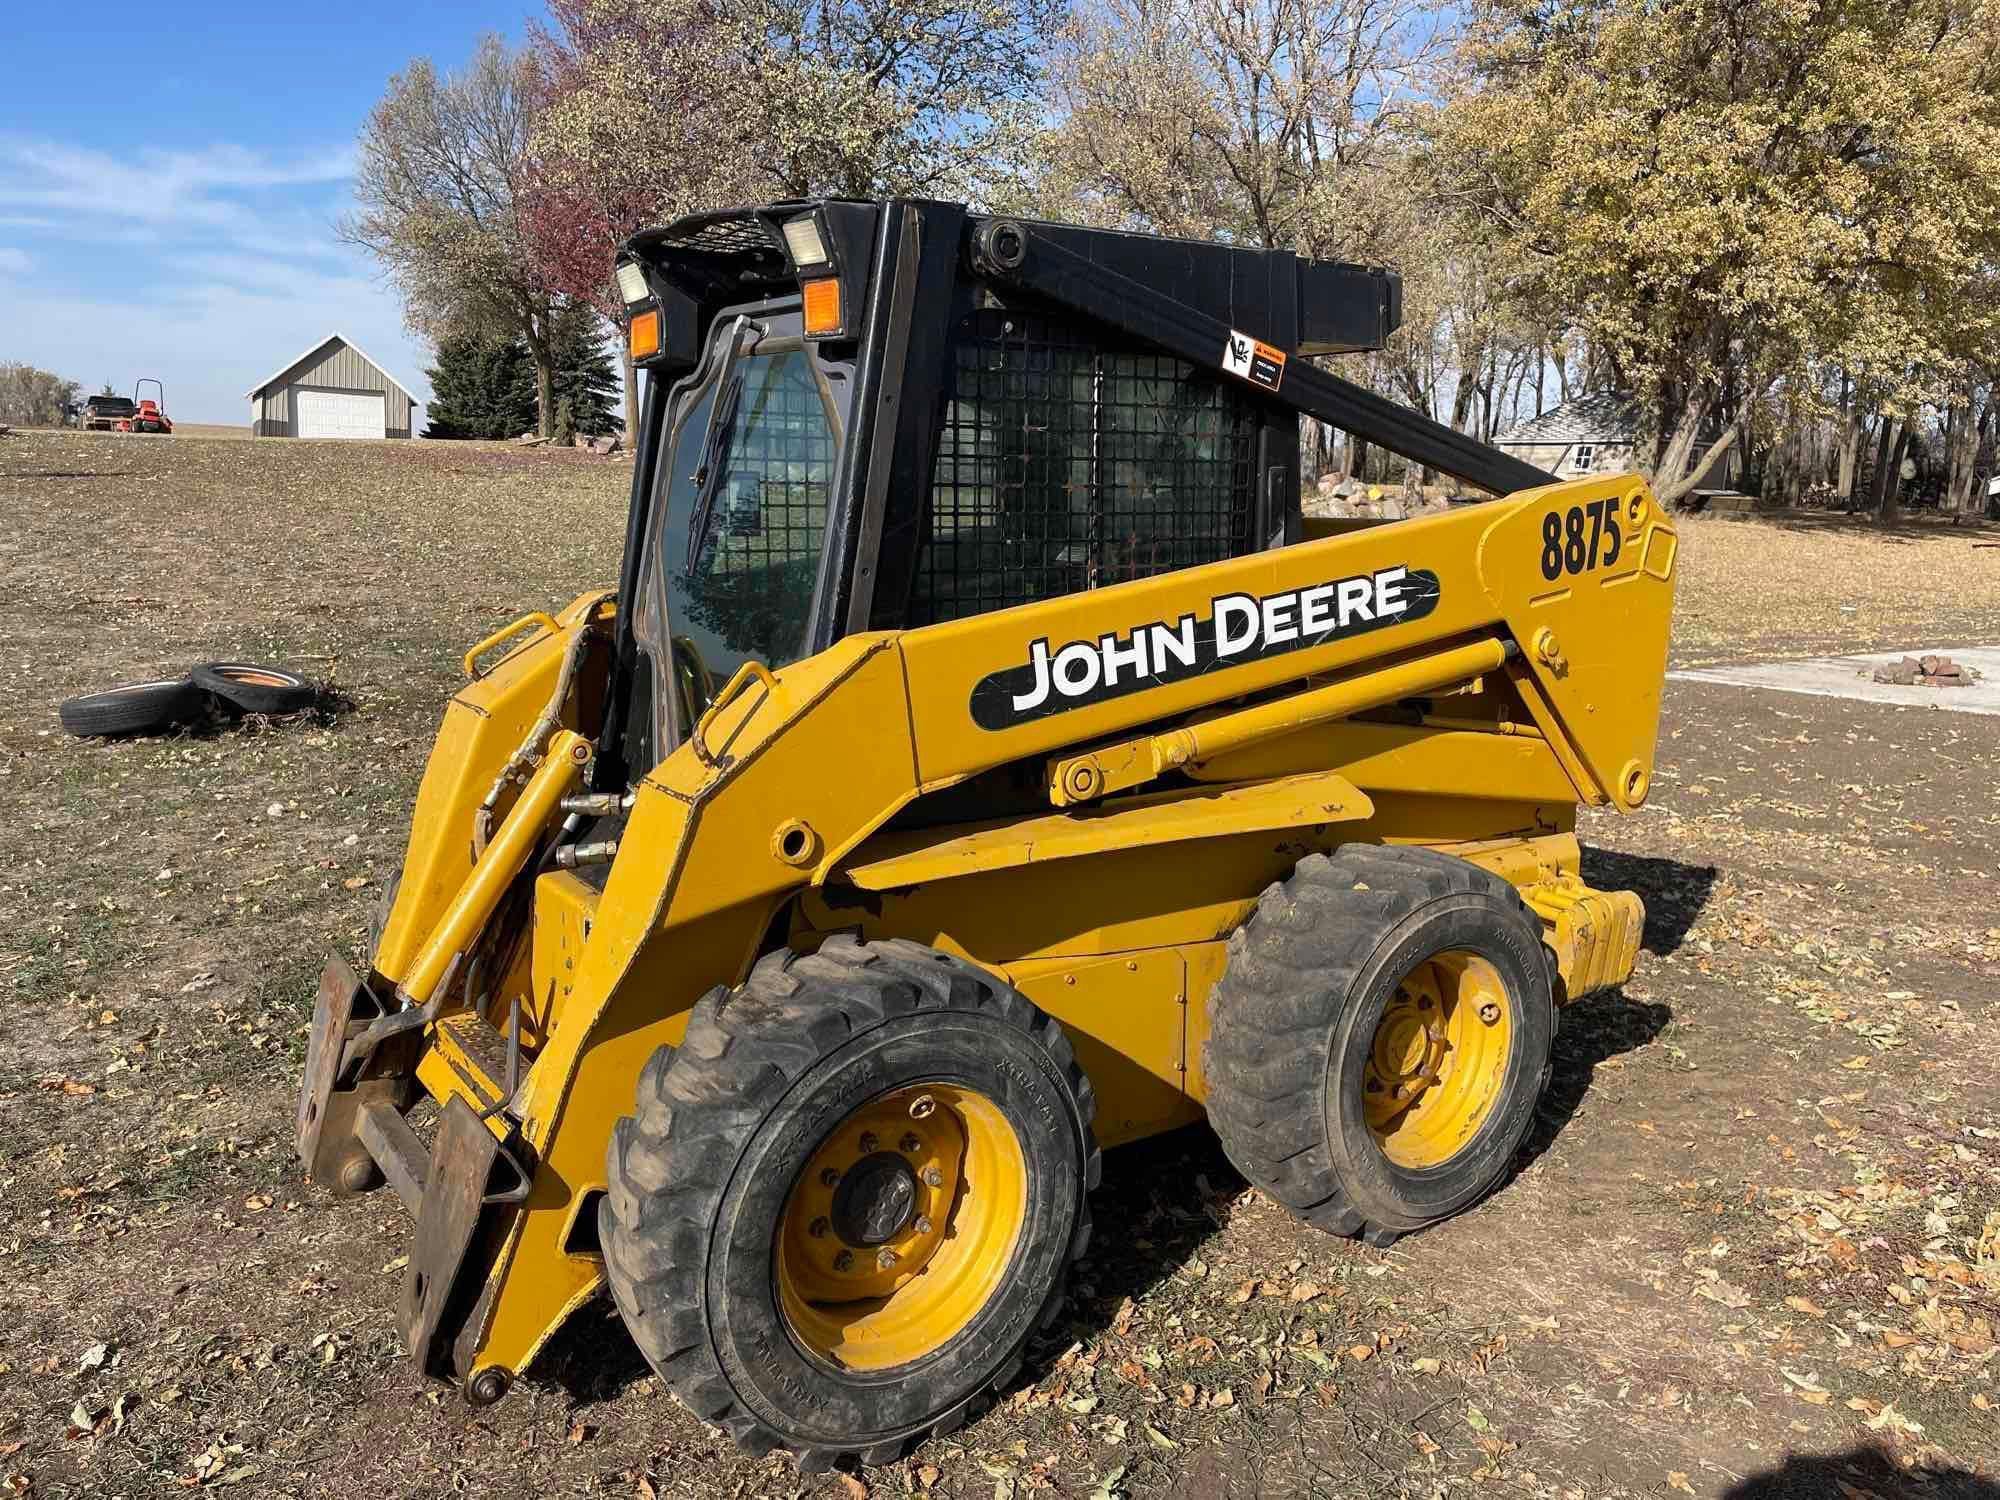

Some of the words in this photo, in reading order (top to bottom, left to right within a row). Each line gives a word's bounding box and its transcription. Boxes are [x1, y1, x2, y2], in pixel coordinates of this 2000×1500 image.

[1541, 496, 1621, 581] 8875
[1012, 616, 1196, 712] JOHN
[1212, 567, 1408, 659] DEERE
